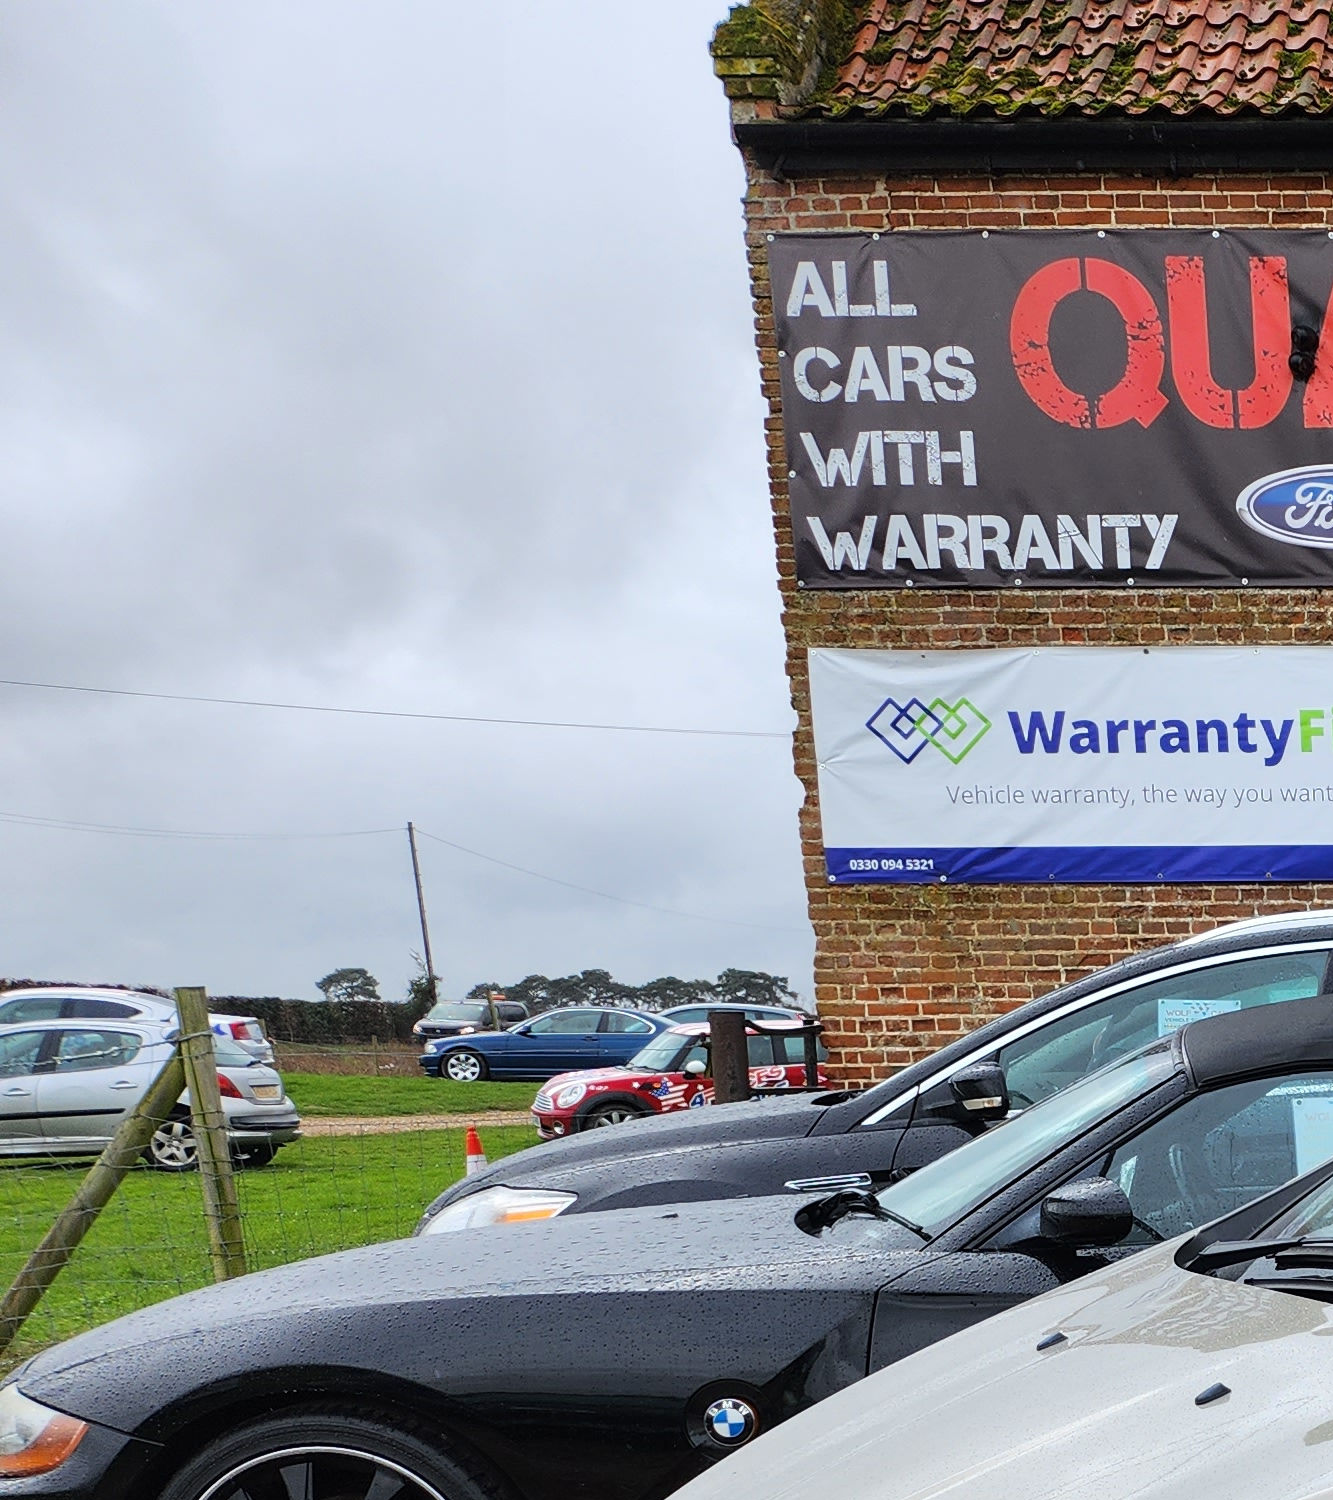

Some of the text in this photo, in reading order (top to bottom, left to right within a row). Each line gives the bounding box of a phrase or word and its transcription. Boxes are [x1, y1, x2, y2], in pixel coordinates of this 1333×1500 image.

[786, 260, 918, 317] ALL
[794, 345, 977, 404] CARS
[800, 430, 977, 488] WITH
[806, 513, 1179, 571] WARRANTY
[946, 784, 1025, 806] Vehicle
[1033, 785, 1135, 809] warranty,
[1142, 783, 1179, 804] the
[1183, 787, 1227, 808] way
[1233, 787, 1274, 809] you
[849, 858, 935, 872] 0330 094 5321
